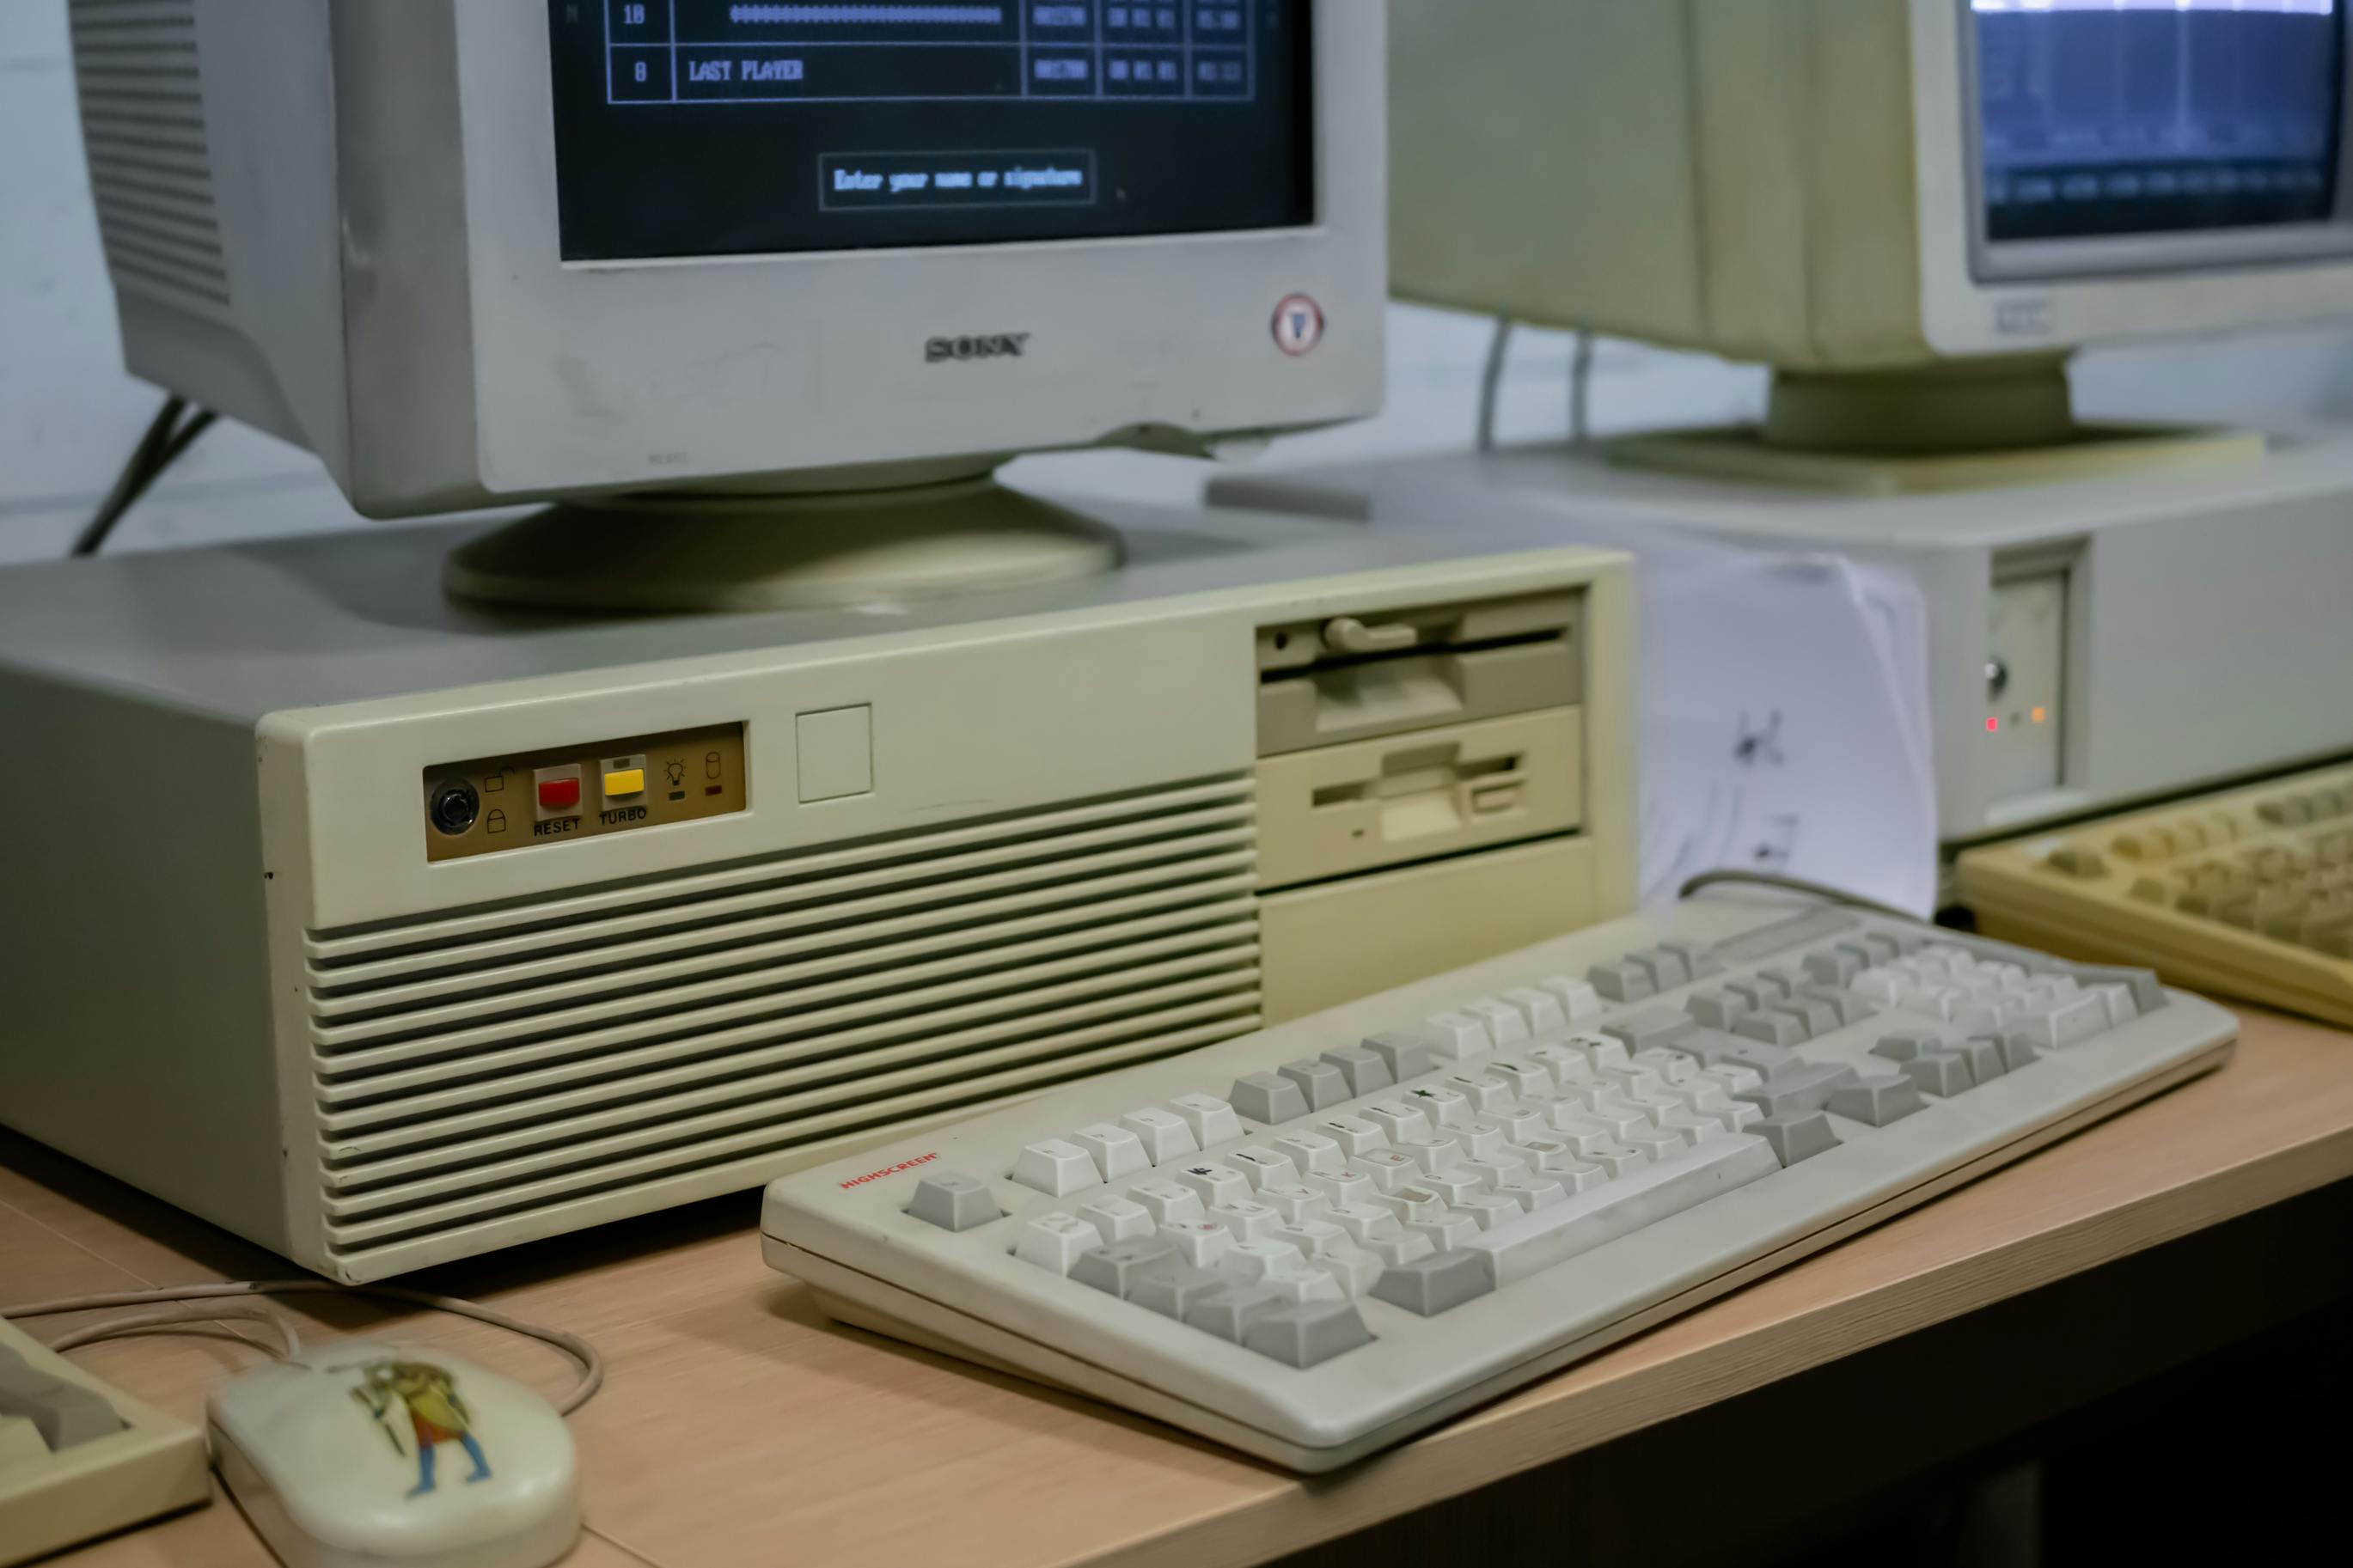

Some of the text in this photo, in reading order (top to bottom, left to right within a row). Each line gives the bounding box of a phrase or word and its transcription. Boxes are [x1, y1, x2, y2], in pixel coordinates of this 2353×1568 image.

[688, 61, 731, 82] LAST
[741, 60, 804, 80] PLAYER
[834, 168, 883, 191] Enter
[925, 332, 1030, 363] SONY
[534, 816, 579, 837] RESET
[599, 806, 648, 826] TURBO
[839, 1152, 938, 1189] HIGHSCREEN
